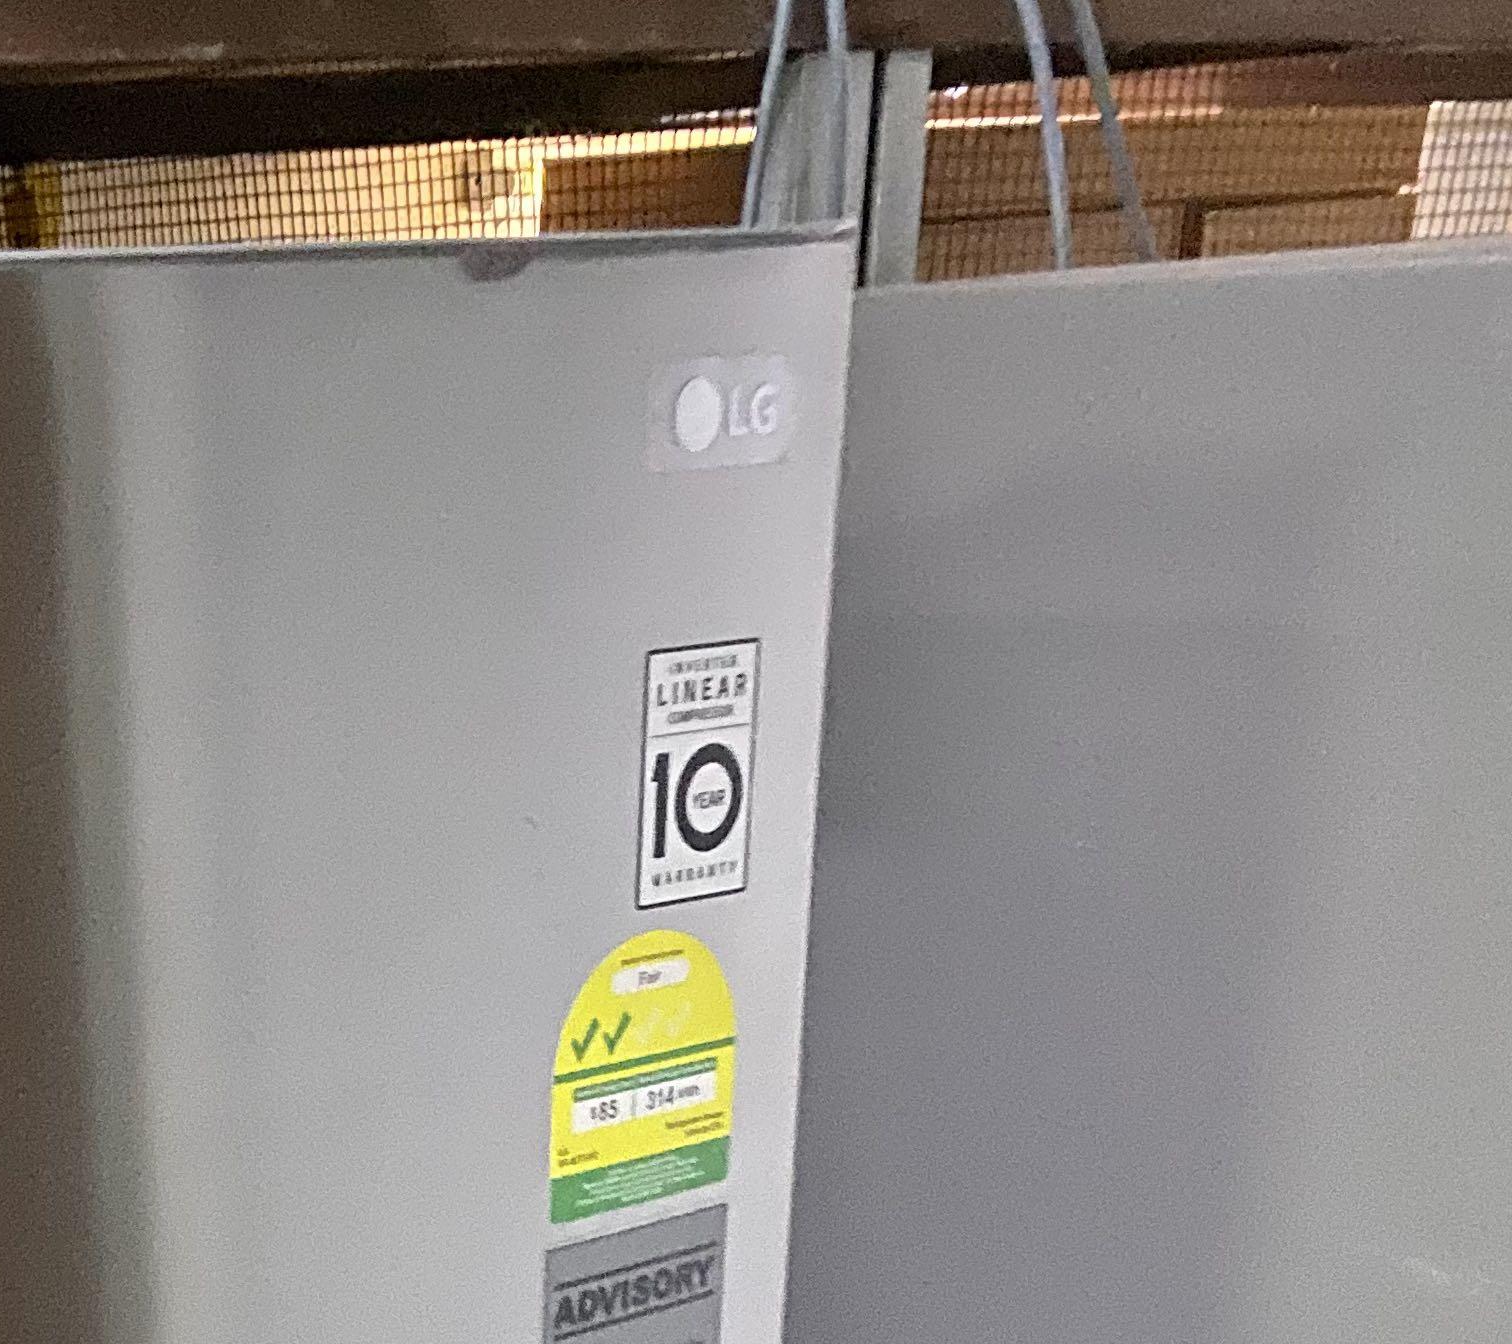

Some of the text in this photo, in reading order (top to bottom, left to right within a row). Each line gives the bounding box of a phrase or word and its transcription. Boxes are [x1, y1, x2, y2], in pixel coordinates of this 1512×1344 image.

[727, 382, 780, 437] LG
[656, 672, 747, 707] LINEAR
[652, 742, 744, 859] 10
[553, 1254, 717, 1330] ADVISORY
